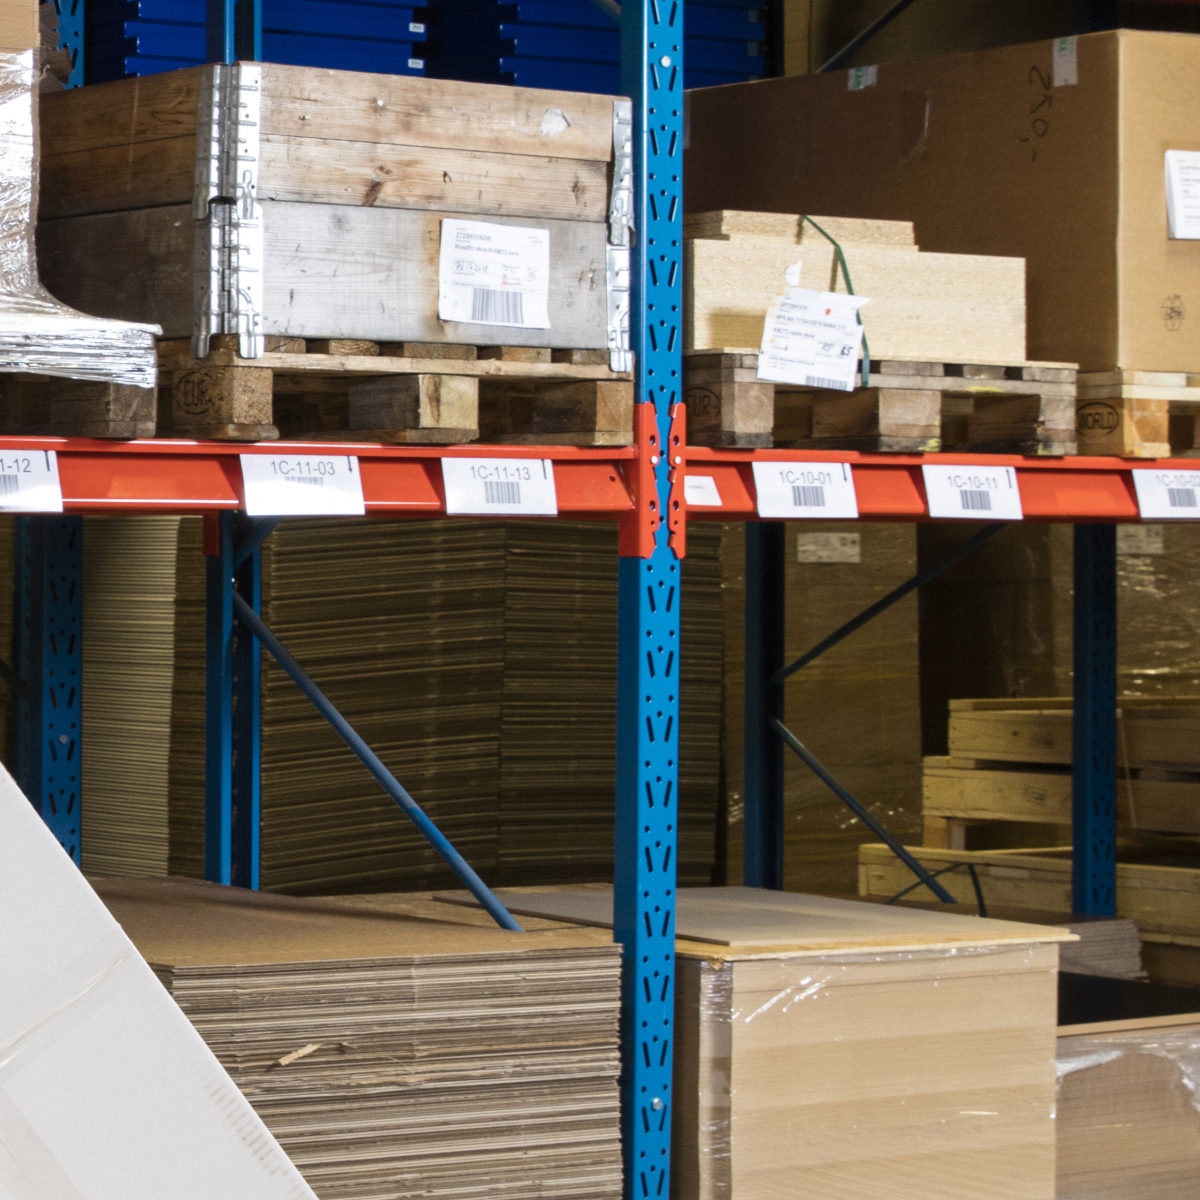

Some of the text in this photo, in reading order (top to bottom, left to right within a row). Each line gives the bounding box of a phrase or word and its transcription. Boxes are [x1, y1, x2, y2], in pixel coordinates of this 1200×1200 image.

[270, 460, 336, 476] 1C-11-03
[469, 465, 531, 481] 1C-11-13
[779, 470, 832, 486] 1C-10-01
[946, 475, 998, 490] 1C-10-11
